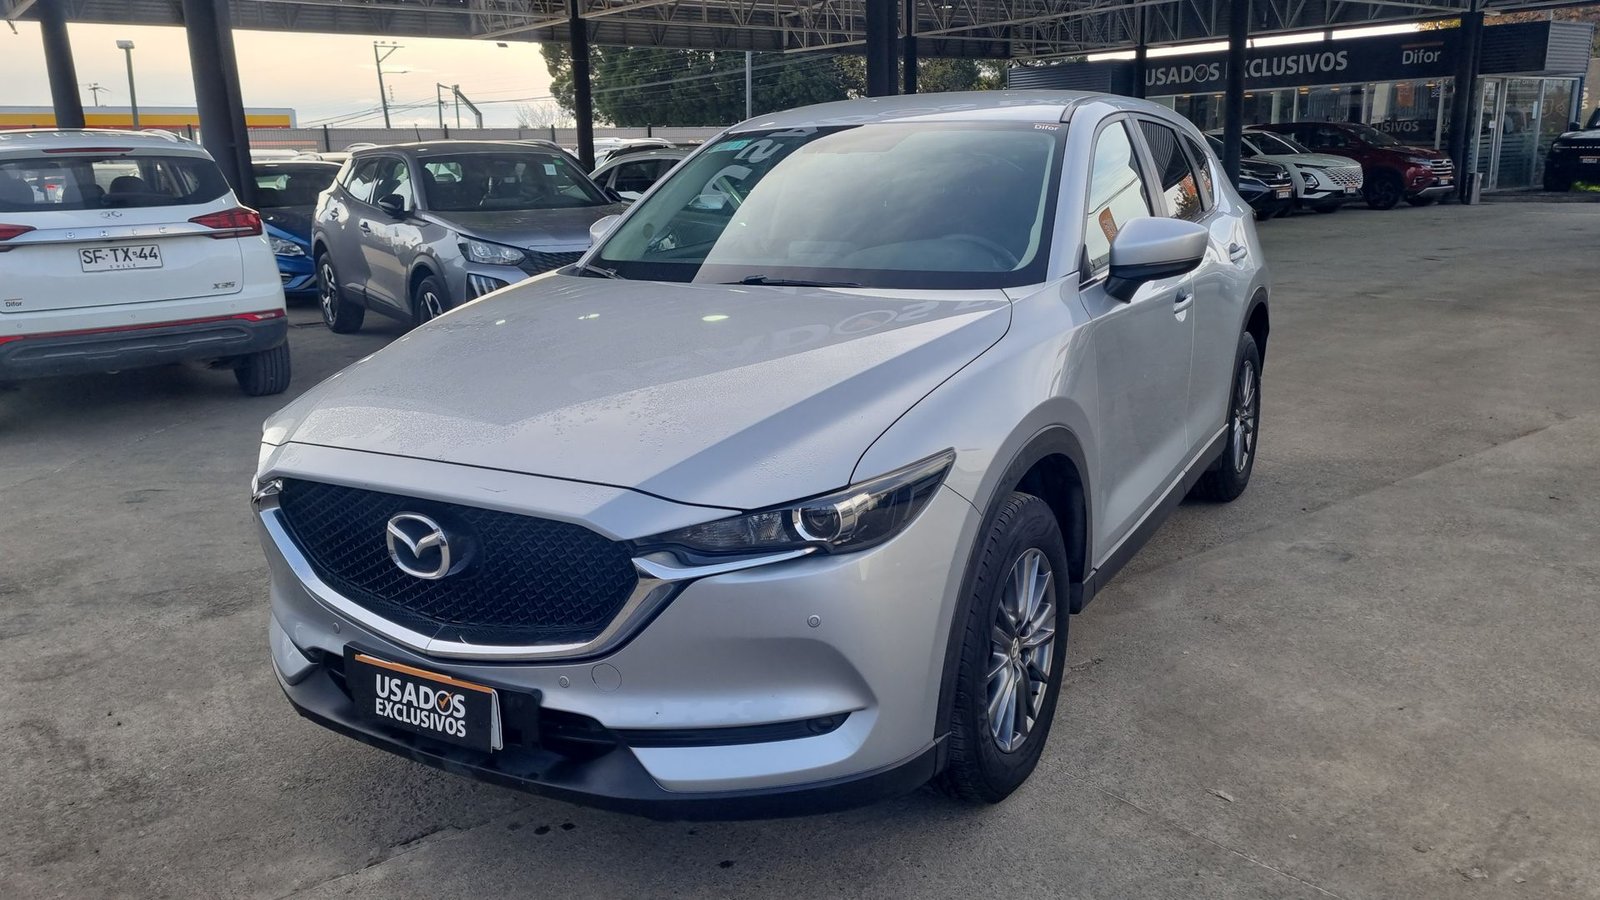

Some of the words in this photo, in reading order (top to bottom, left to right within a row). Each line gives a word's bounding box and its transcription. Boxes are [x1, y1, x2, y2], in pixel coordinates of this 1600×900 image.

[1145, 62, 1220, 86] USADOS
[1225, 51, 1348, 79] CLUSIVOS
[1402, 49, 1441, 64] Difor
[375, 673, 466, 719] USADOS
[375, 697, 467, 738] EXCLUSIVOS
